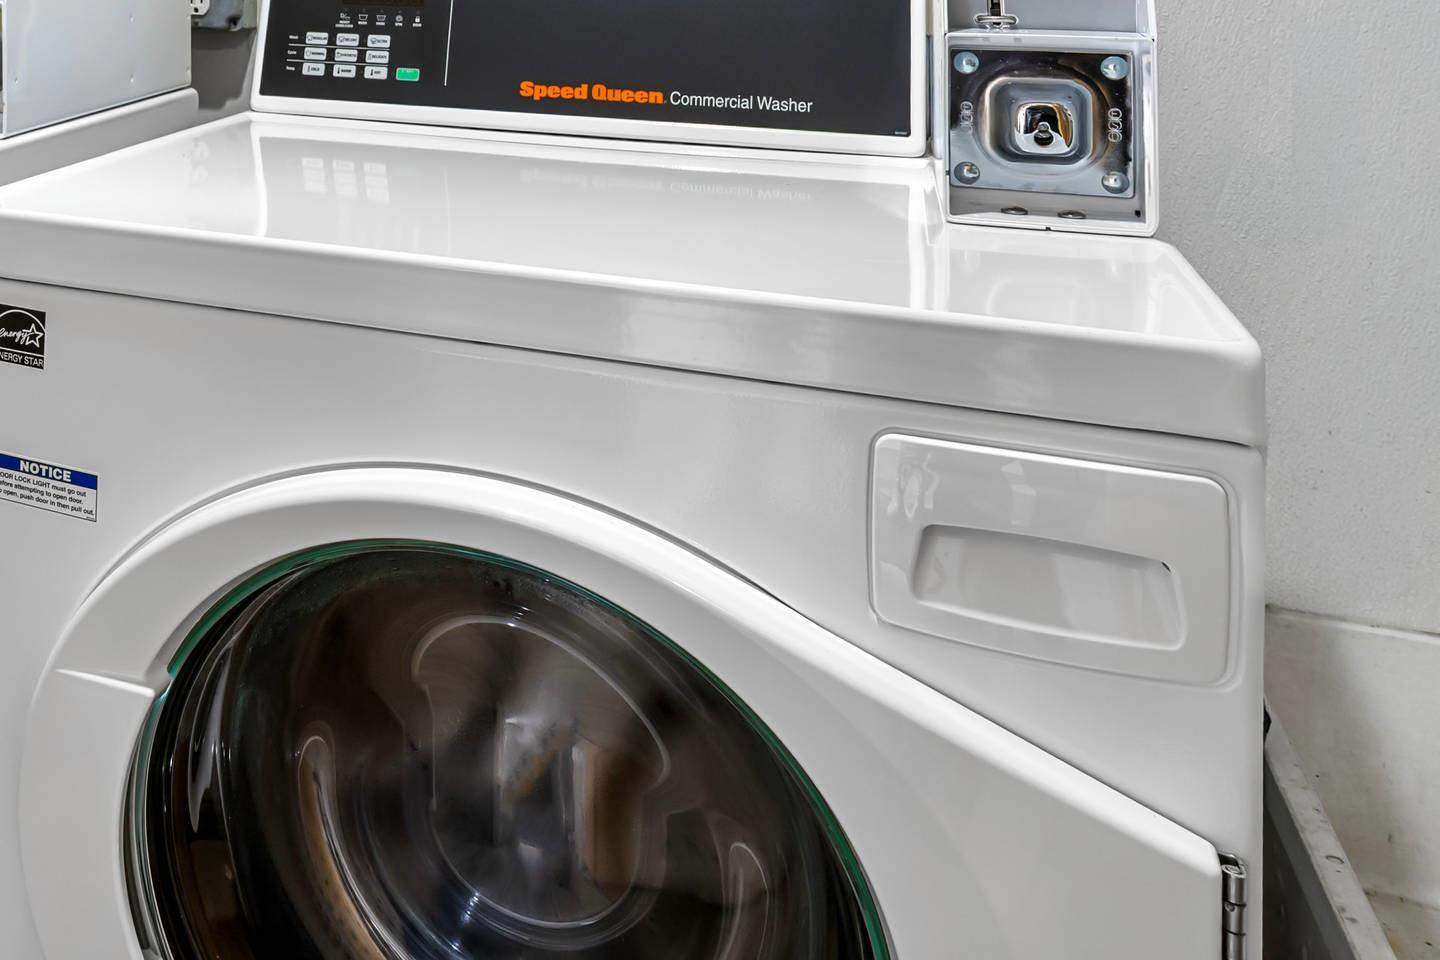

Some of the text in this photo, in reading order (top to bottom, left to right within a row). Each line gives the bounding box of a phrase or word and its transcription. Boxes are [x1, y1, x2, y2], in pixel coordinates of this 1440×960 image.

[519, 80, 813, 113] Speed Queen Commercial Washer
[23, 355, 44, 368] STAR
[20, 460, 72, 482] NOTICE
[14, 474, 31, 484] LOCK
[32, 478, 50, 488] LIGHT
[51, 484, 67, 492] must
[14, 483, 45, 496] attempting
[52, 493, 67, 501] open
[68, 496, 84, 505] door.
[19, 493, 35, 501] push
[35, 495, 49, 504] door
[50, 498, 56, 506] in
[56, 501, 70, 510] then
[70, 504, 82, 513] pull
[83, 507, 95, 516] out.
